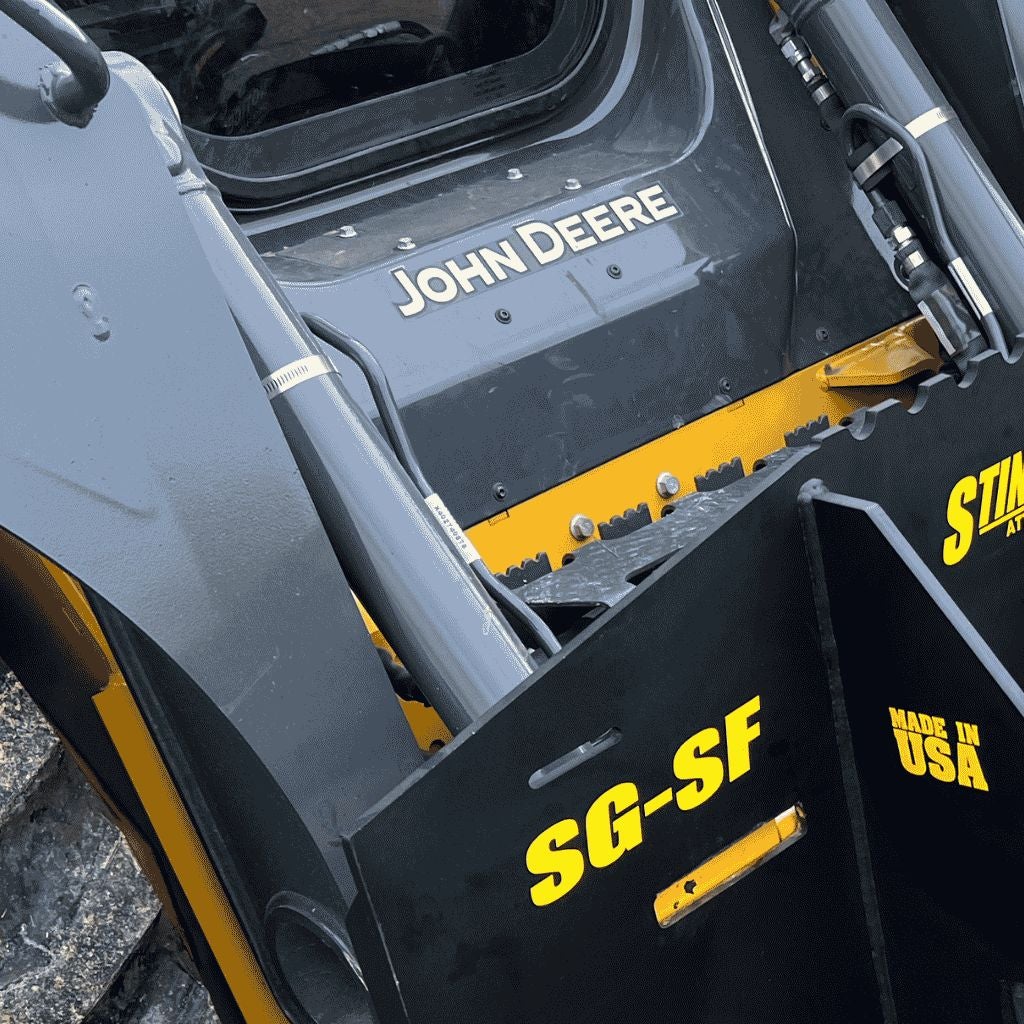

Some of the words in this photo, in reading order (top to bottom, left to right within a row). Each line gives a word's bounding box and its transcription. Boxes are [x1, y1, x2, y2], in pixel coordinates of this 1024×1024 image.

[391, 240, 528, 317] JOHN
[515, 184, 678, 265] DEERE
[888, 707, 948, 739] MADE
[955, 721, 980, 746] IN
[893, 728, 989, 792] USA
[525, 695, 761, 907] SG-SF
